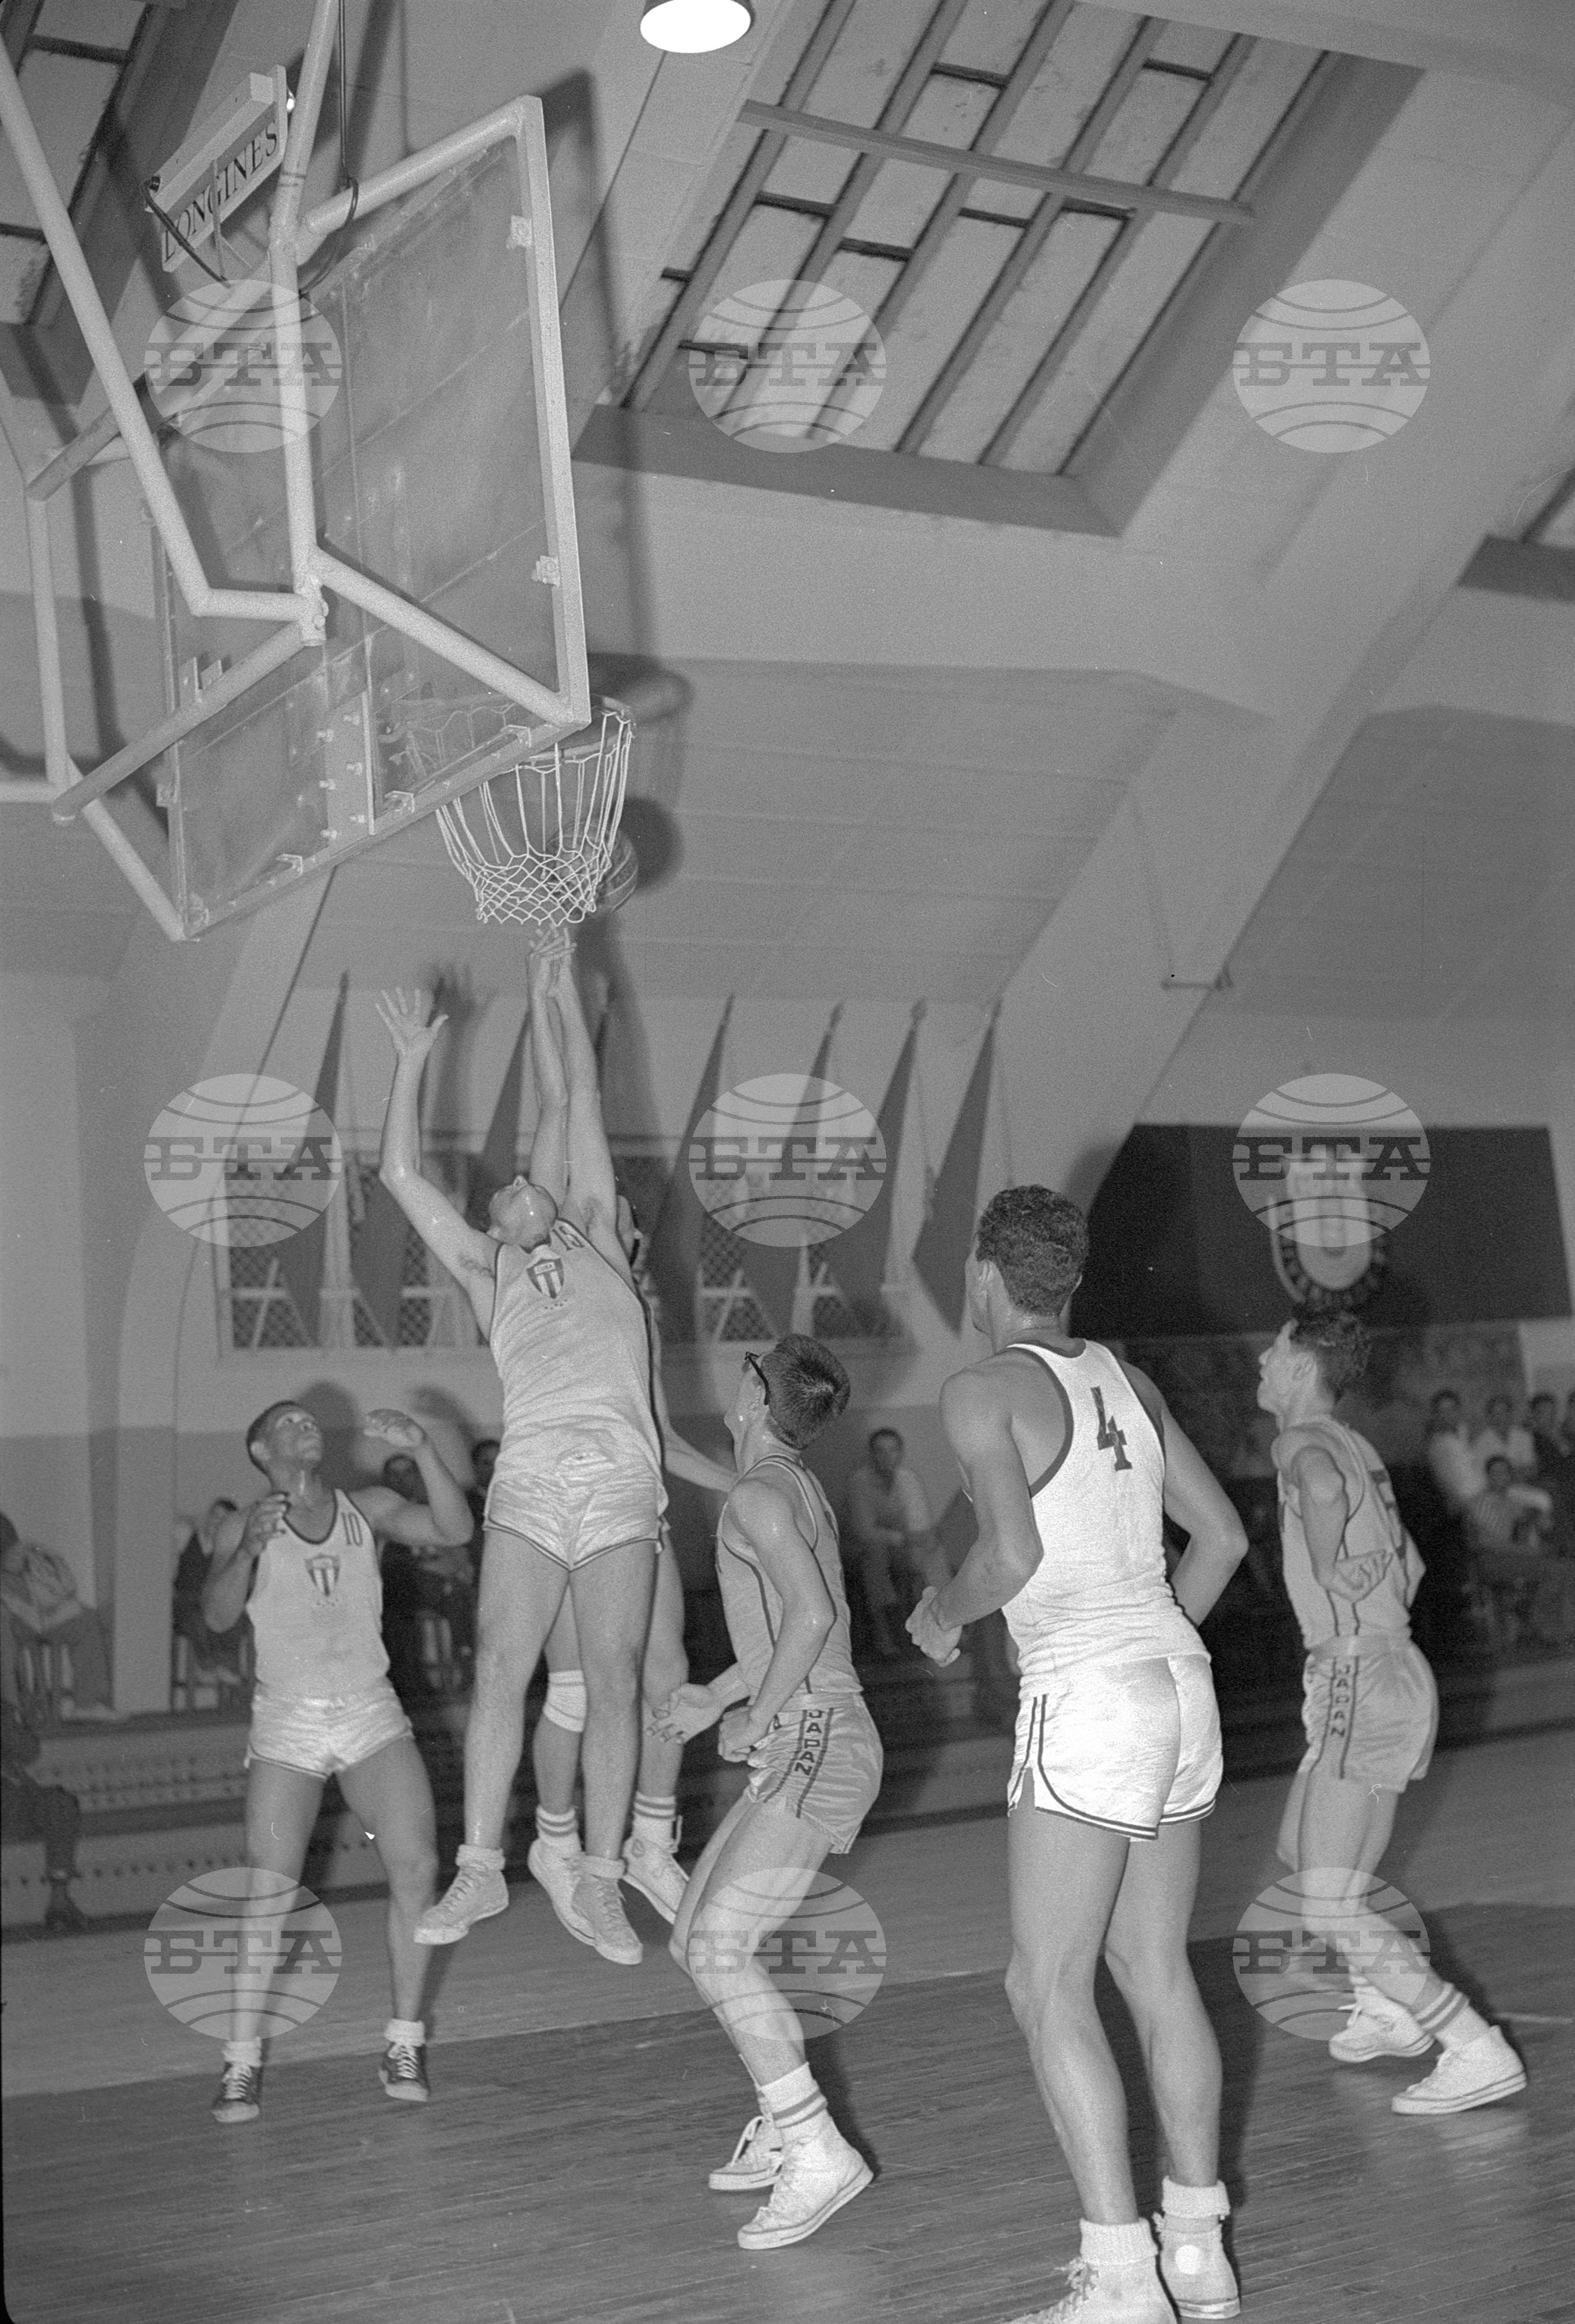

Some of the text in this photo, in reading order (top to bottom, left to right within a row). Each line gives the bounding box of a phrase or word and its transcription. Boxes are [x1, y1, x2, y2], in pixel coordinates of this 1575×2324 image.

[164, 121, 278, 263] LONGINES
[1090, 1386, 1133, 1472] 4
[340, 1512, 363, 1547] 10
[1330, 1665, 1351, 1738] JAPAN
[793, 1709, 825, 1776] JAPAN
